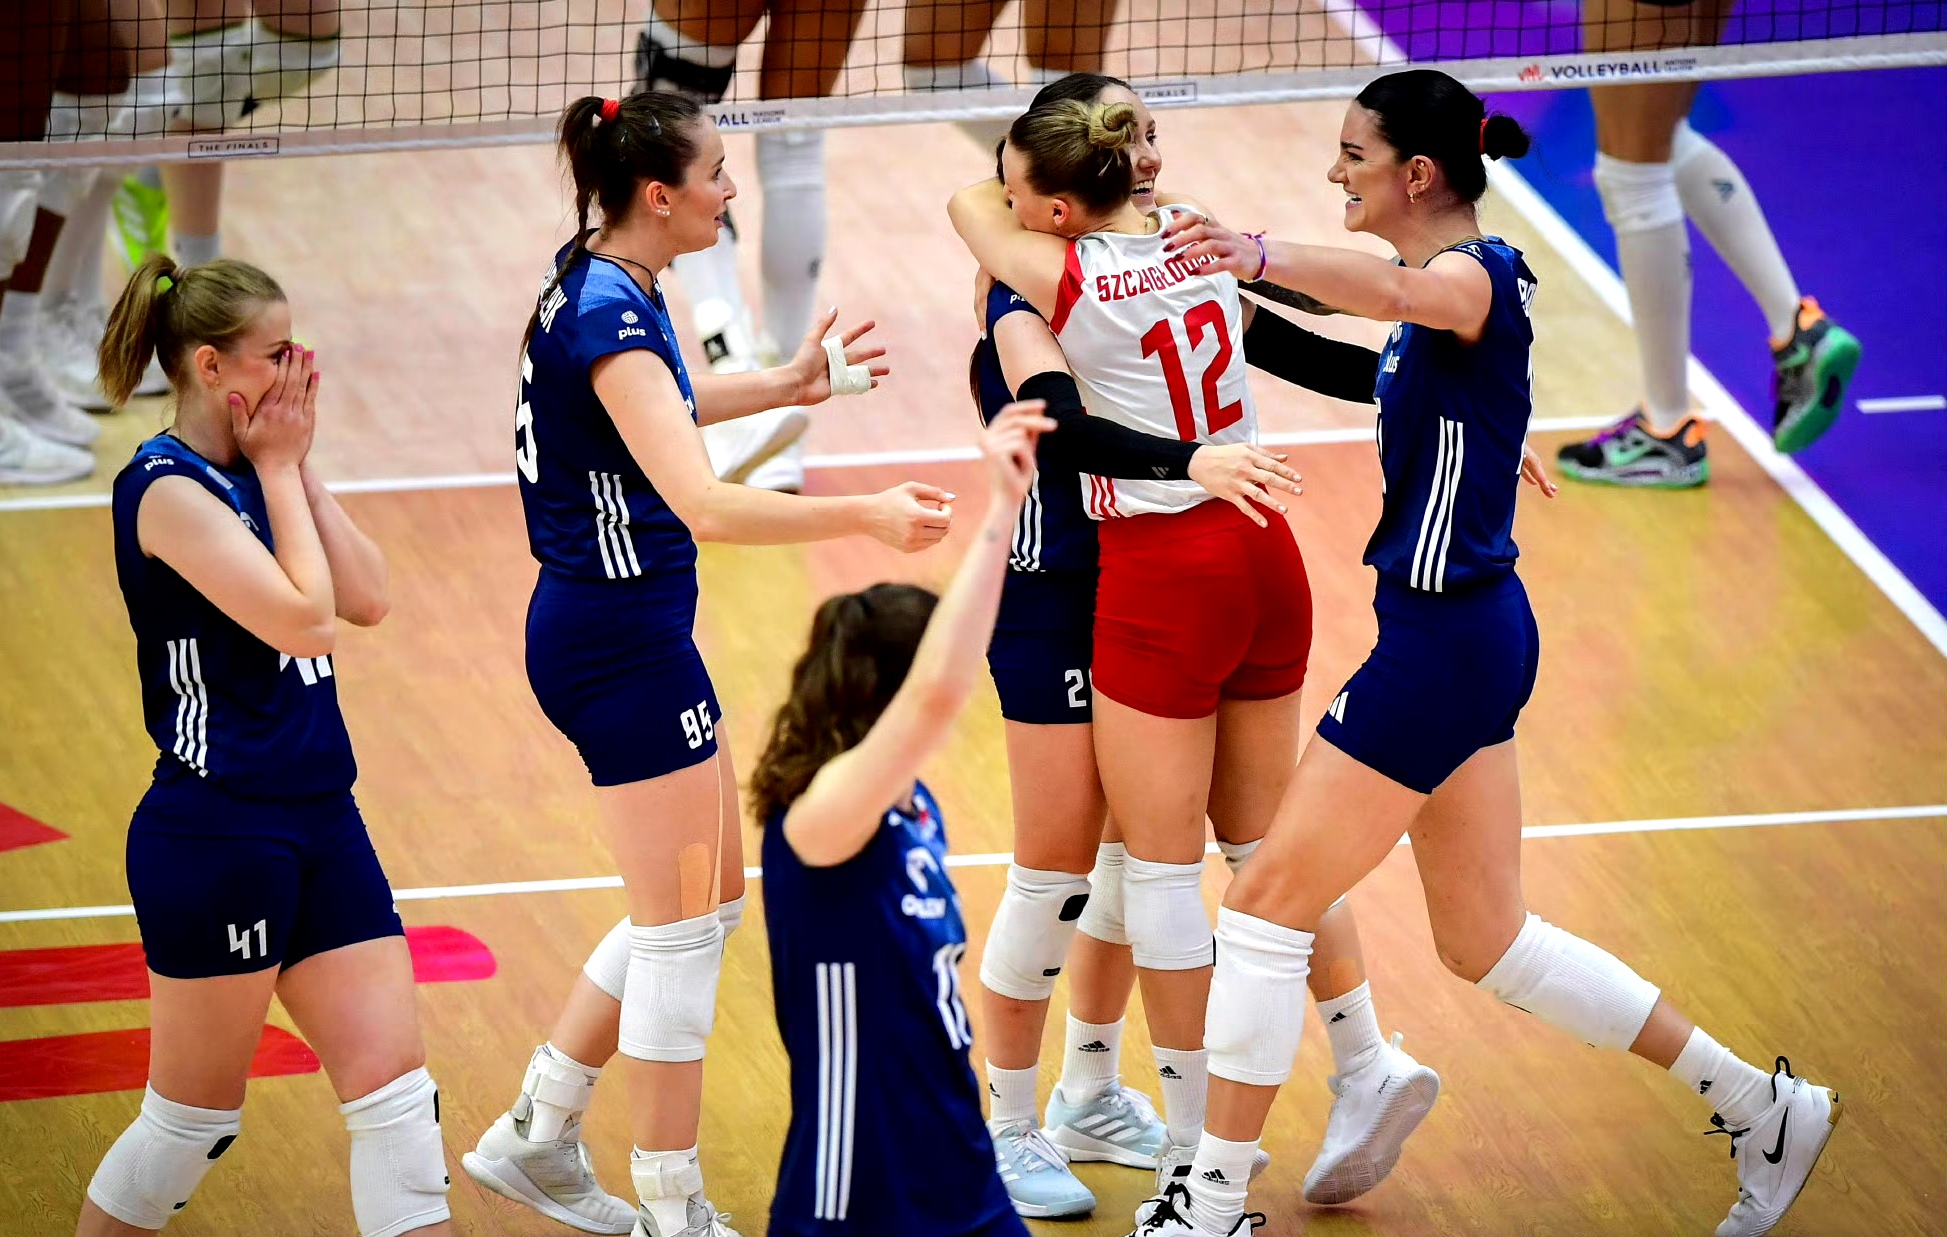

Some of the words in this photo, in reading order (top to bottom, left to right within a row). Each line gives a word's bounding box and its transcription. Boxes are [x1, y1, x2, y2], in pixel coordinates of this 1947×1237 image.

[1552, 61, 1661, 78] VOLLEYBALL
[709, 113, 749, 127] ALL
[199, 144, 220, 152] THE
[226, 141, 268, 150] FINALS
[618, 327, 646, 340] plus
[1140, 299, 1244, 443] 12
[144, 458, 175, 471] plus
[1064, 668, 1093, 708] 2
[680, 699, 714, 750] 95
[227, 918, 267, 960] 41
